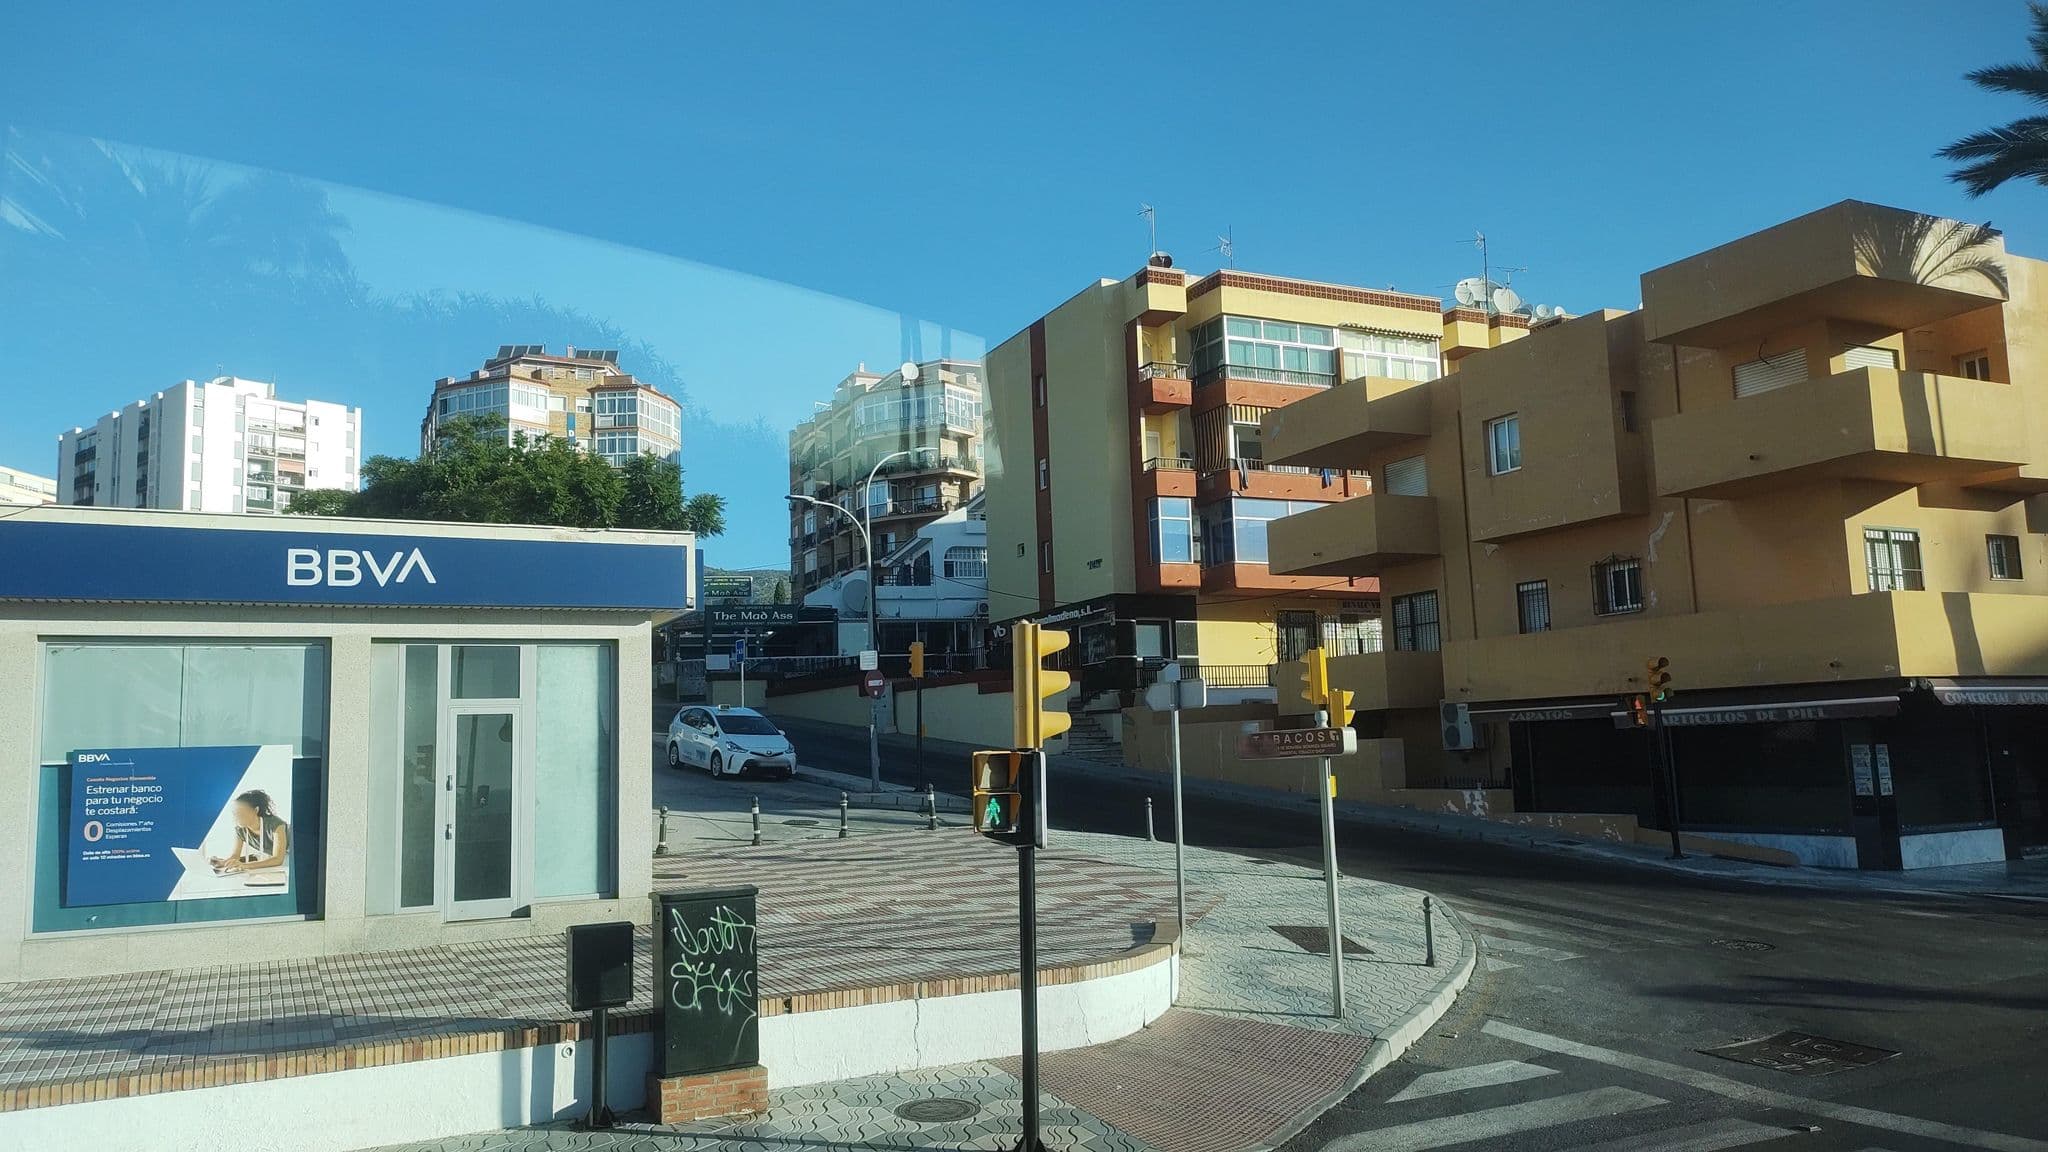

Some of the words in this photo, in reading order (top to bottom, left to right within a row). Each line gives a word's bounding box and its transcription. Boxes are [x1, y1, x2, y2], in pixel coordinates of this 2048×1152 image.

[287, 547, 437, 587] BBVA
[713, 611, 737, 621] The
[741, 611, 768, 620] Mad
[772, 611, 793, 620] Ass
[1944, 692, 2009, 703] COMERCIAL
[1758, 709, 1777, 721] DE
[78, 753, 110, 763] BBVA
[86, 785, 130, 795] Estrenar
[131, 784, 162, 793] banco
[85, 797, 109, 807] para
[111, 796, 122, 804] tu
[123, 795, 163, 805] negocio
[85, 807, 96, 816] te
[97, 805, 138, 815] costará:
